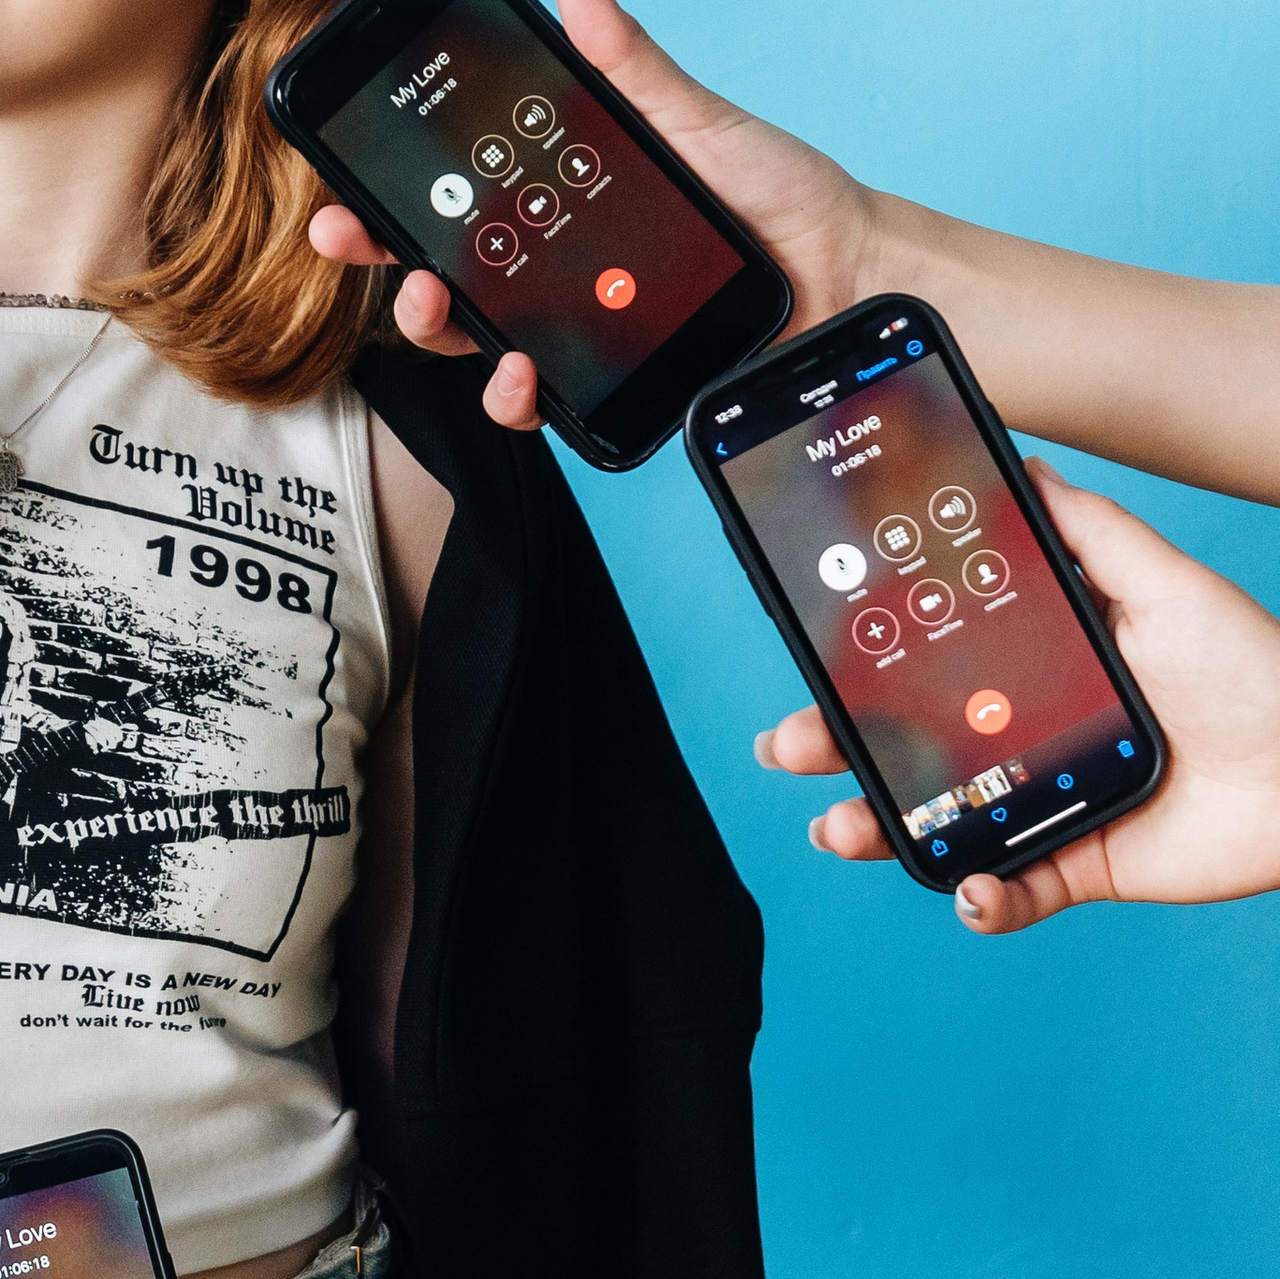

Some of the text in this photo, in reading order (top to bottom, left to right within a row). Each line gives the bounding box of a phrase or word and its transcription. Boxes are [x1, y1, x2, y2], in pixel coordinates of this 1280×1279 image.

[390, 52, 450, 108] My Love
[418, 78, 457, 115] 01:06:18
[542, 127, 565, 150] speaker
[501, 166, 524, 189] keypad
[586, 175, 612, 200] contacts
[464, 209, 480, 225] mute
[543, 213, 572, 240] FaceTime
[505, 253, 529, 278] add call
[805, 415, 882, 463] My Love
[89, 424, 337, 518] Turn up the
[831, 444, 882, 477] 01:06:18
[181, 484, 336, 555] Volume
[146, 534, 312, 614] 1998
[17, 794, 345, 850] experience the thrill
[61, 965, 116, 982] DAY
[125, 972, 151, 989] IS
[161, 974, 178, 991] A
[183, 972, 238, 990] NEW
[239, 982, 281, 998] DAY
[81, 983, 200, 1016] Live now
[20, 1014, 70, 1028] don't
[76, 1014, 118, 1028] wait
[124, 1016, 153, 1029] for
[160, 1021, 192, 1032] the
[5, 1222, 58, 1250] Love
